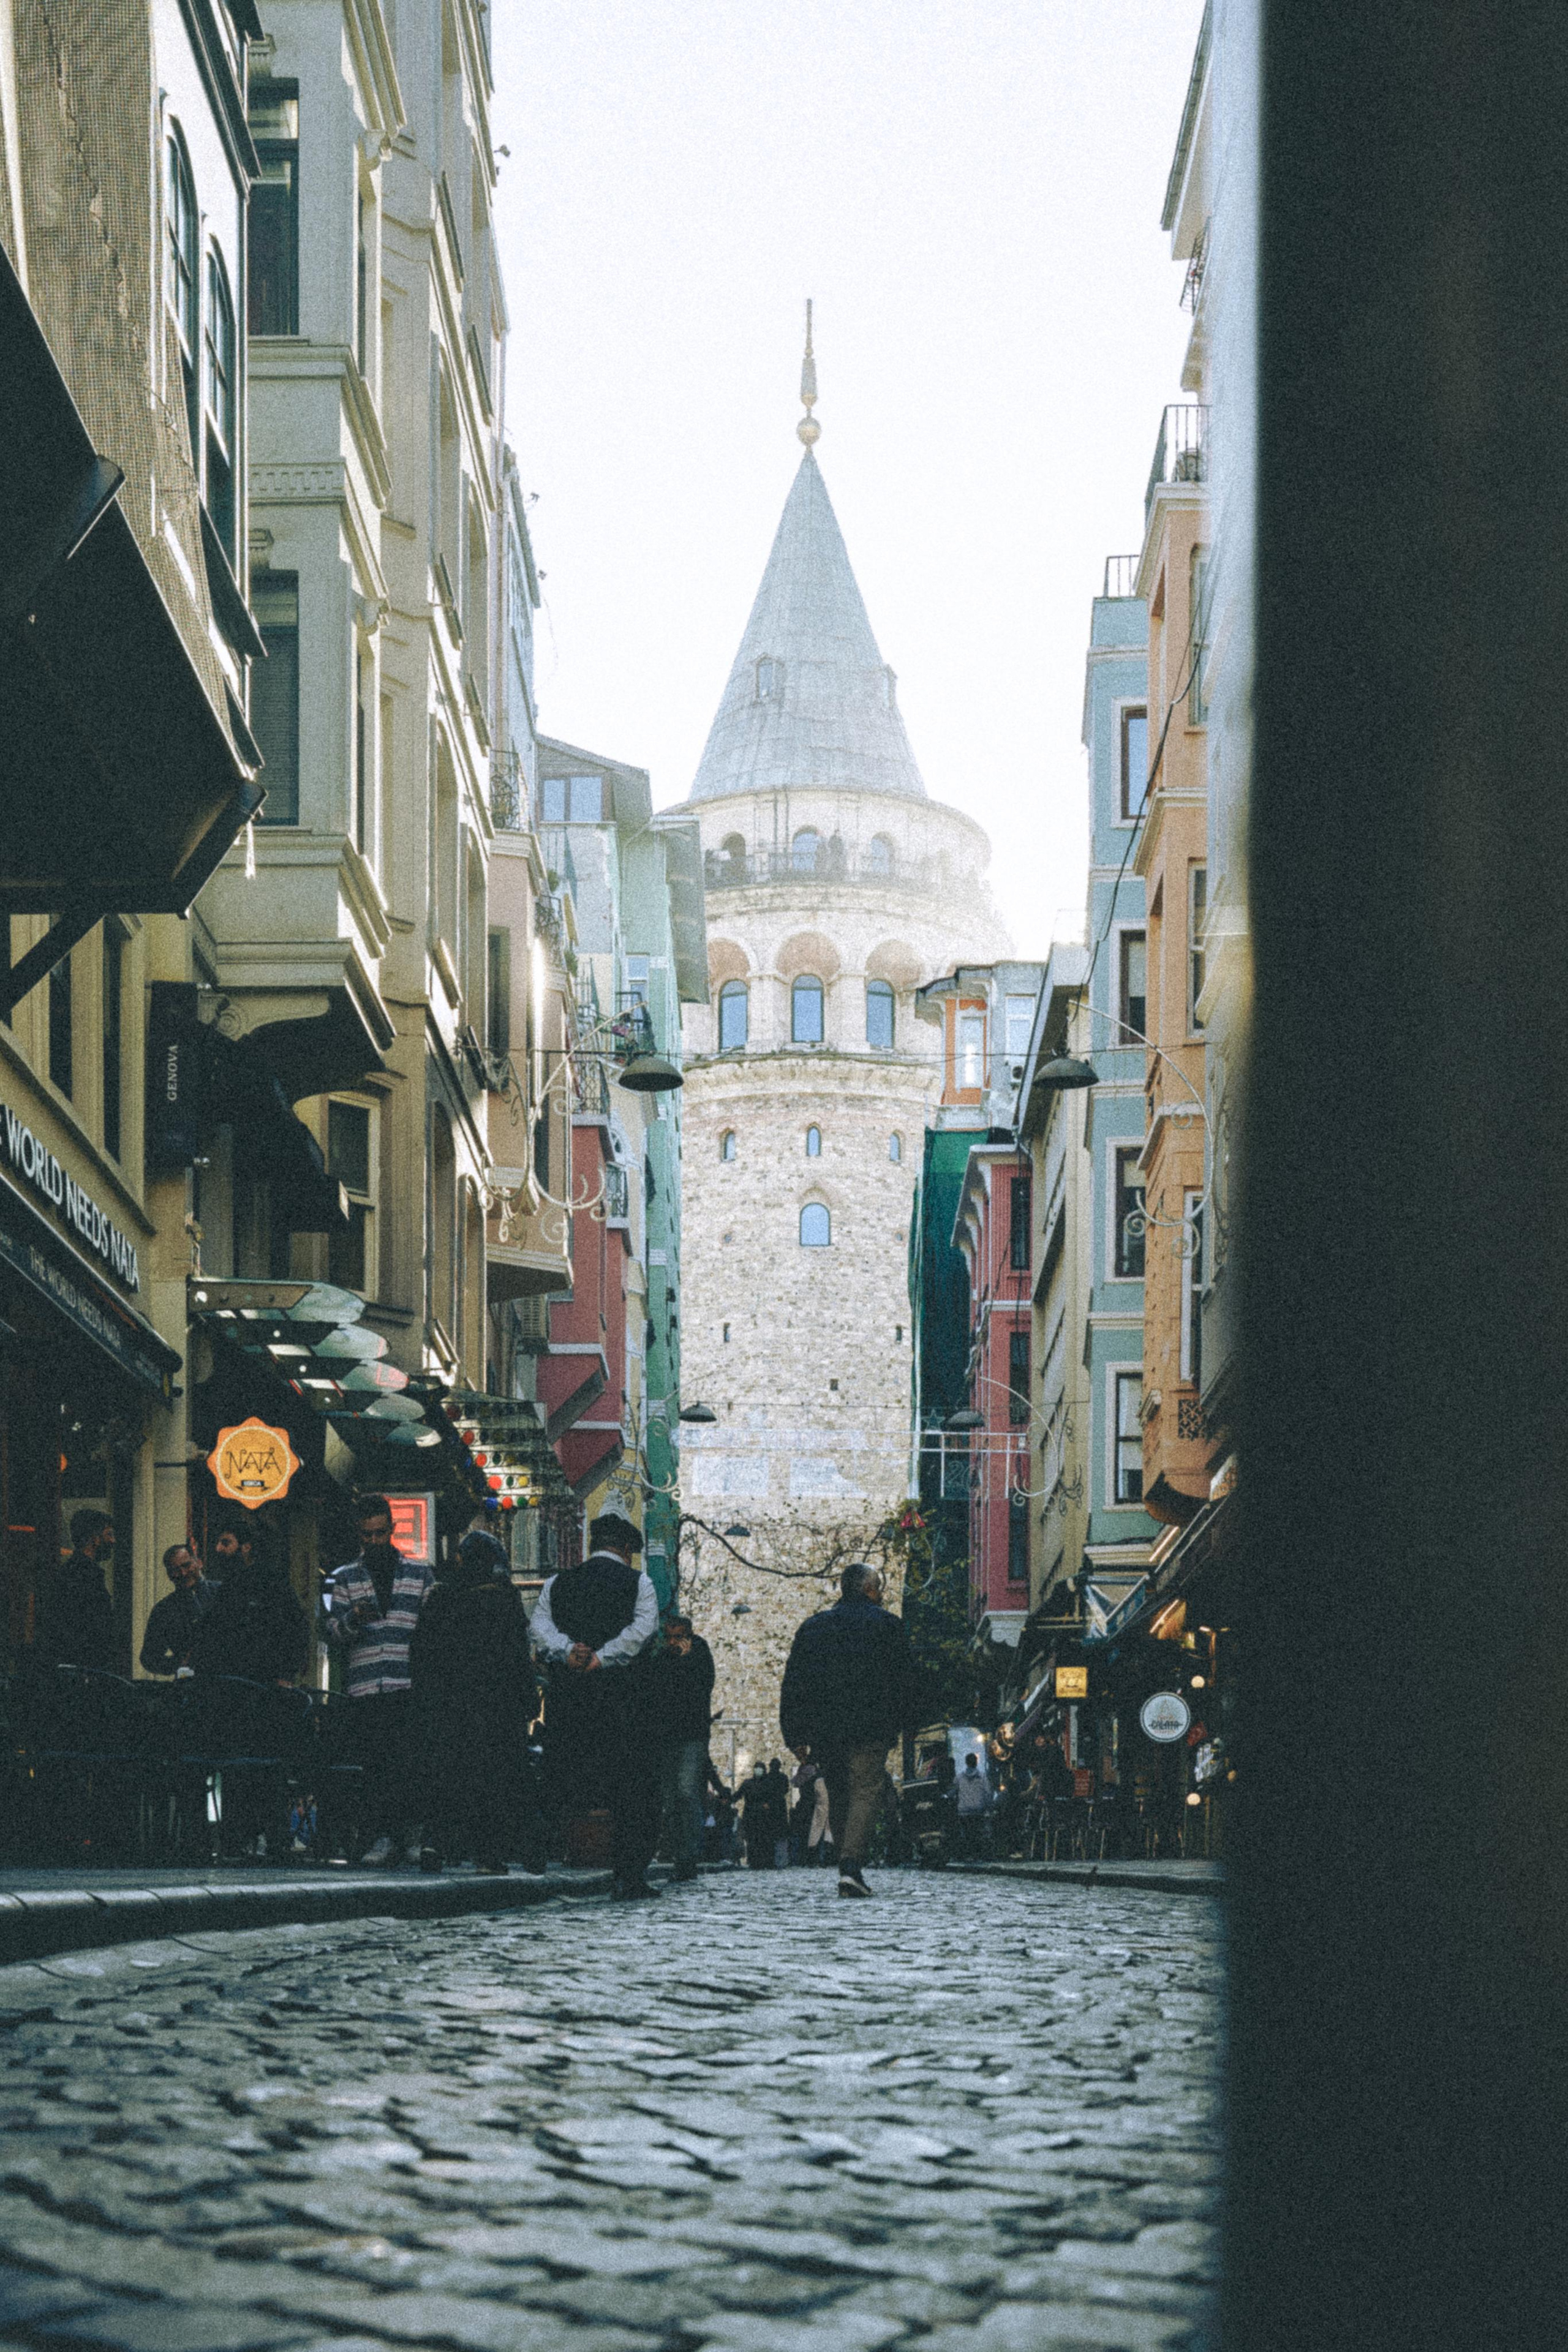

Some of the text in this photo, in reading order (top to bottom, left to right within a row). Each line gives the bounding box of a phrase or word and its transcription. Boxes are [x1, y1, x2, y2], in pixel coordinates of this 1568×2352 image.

[167, 1044, 178, 1101] GENOVA
[6, 1104, 140, 1292] WORLD NEEDS NATA
[224, 1447, 282, 1479] NATA
